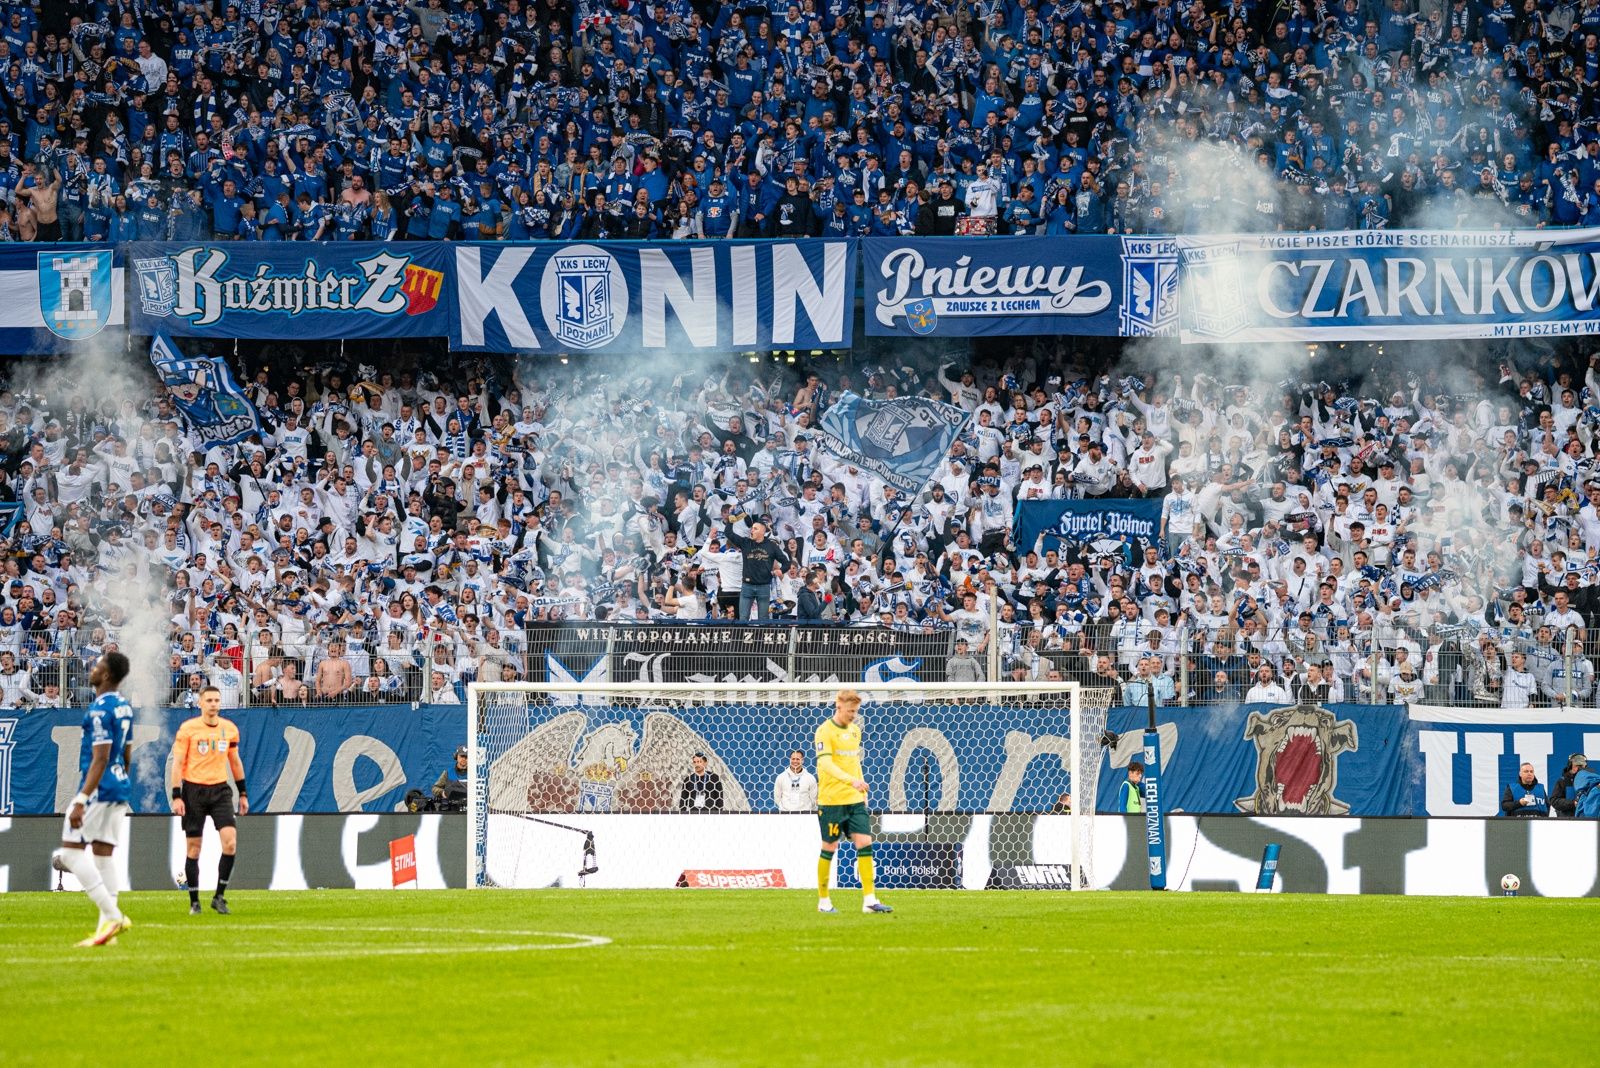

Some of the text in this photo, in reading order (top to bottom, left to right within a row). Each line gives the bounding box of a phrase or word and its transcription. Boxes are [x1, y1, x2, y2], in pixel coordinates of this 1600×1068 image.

[1306, 235, 1349, 247] PISZE
[1355, 231, 1404, 246] RÓŻNE
[1130, 242, 1179, 254] KKS LEC
[560, 259, 606, 269] KKS LECH
[878, 247, 1086, 308] Pniewy
[456, 243, 848, 349] KONIN
[946, 299, 1041, 313] ZAWSZE Z LECHEM
[1519, 323, 1580, 336] PISZEMY
[744, 632, 754, 644] Z
[839, 630, 897, 646] KOŚCI
[1145, 777, 1161, 845] LECH POZNAŃ
[828, 822, 840, 837] 14
[394, 851, 416, 873] STIHL
[884, 865, 940, 877] Bank Polski
[696, 872, 774, 889] SUPERBET
